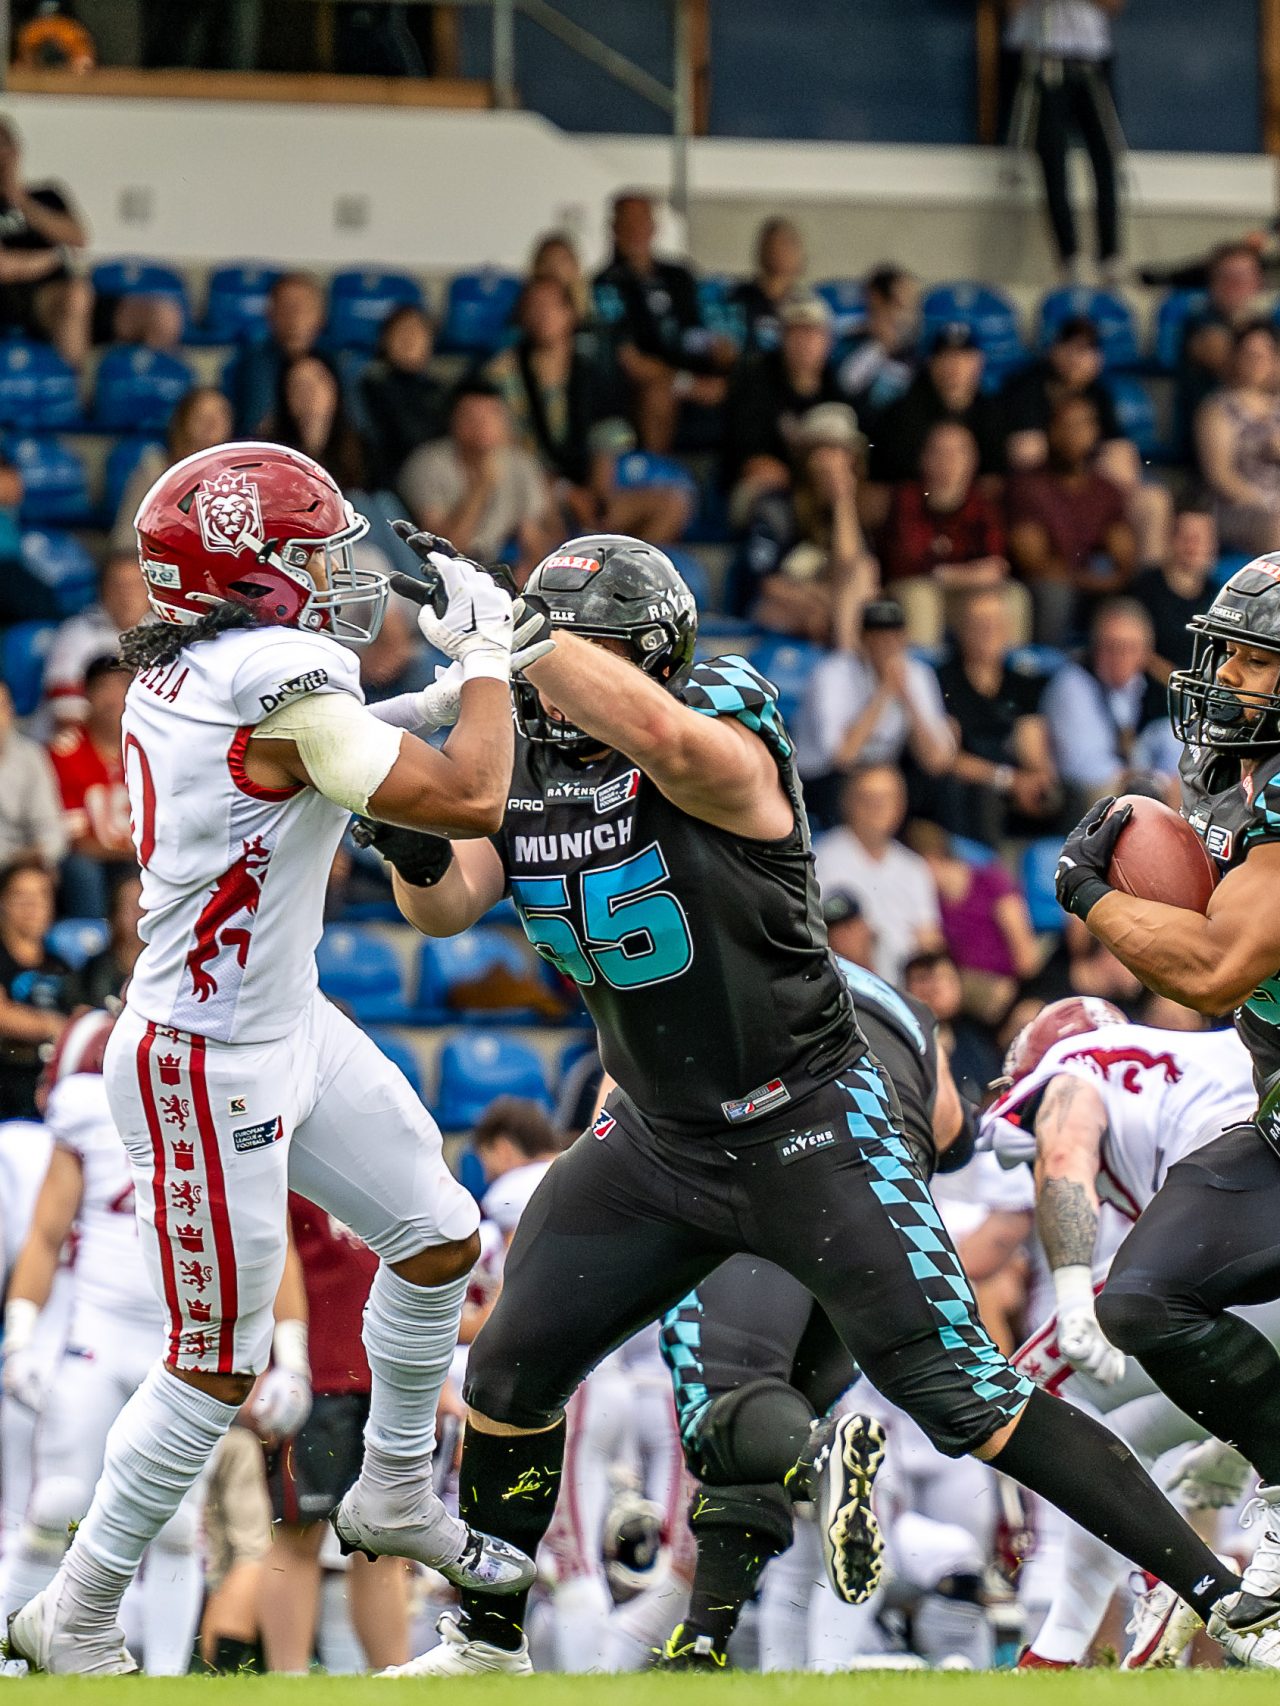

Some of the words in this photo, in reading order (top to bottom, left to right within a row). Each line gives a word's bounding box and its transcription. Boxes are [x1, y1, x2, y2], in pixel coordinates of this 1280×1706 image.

[547, 782, 597, 798] RAVENS
[515, 816, 633, 862] MUNICH
[509, 841, 694, 990] 55
[782, 1130, 834, 1157] RAVENS
